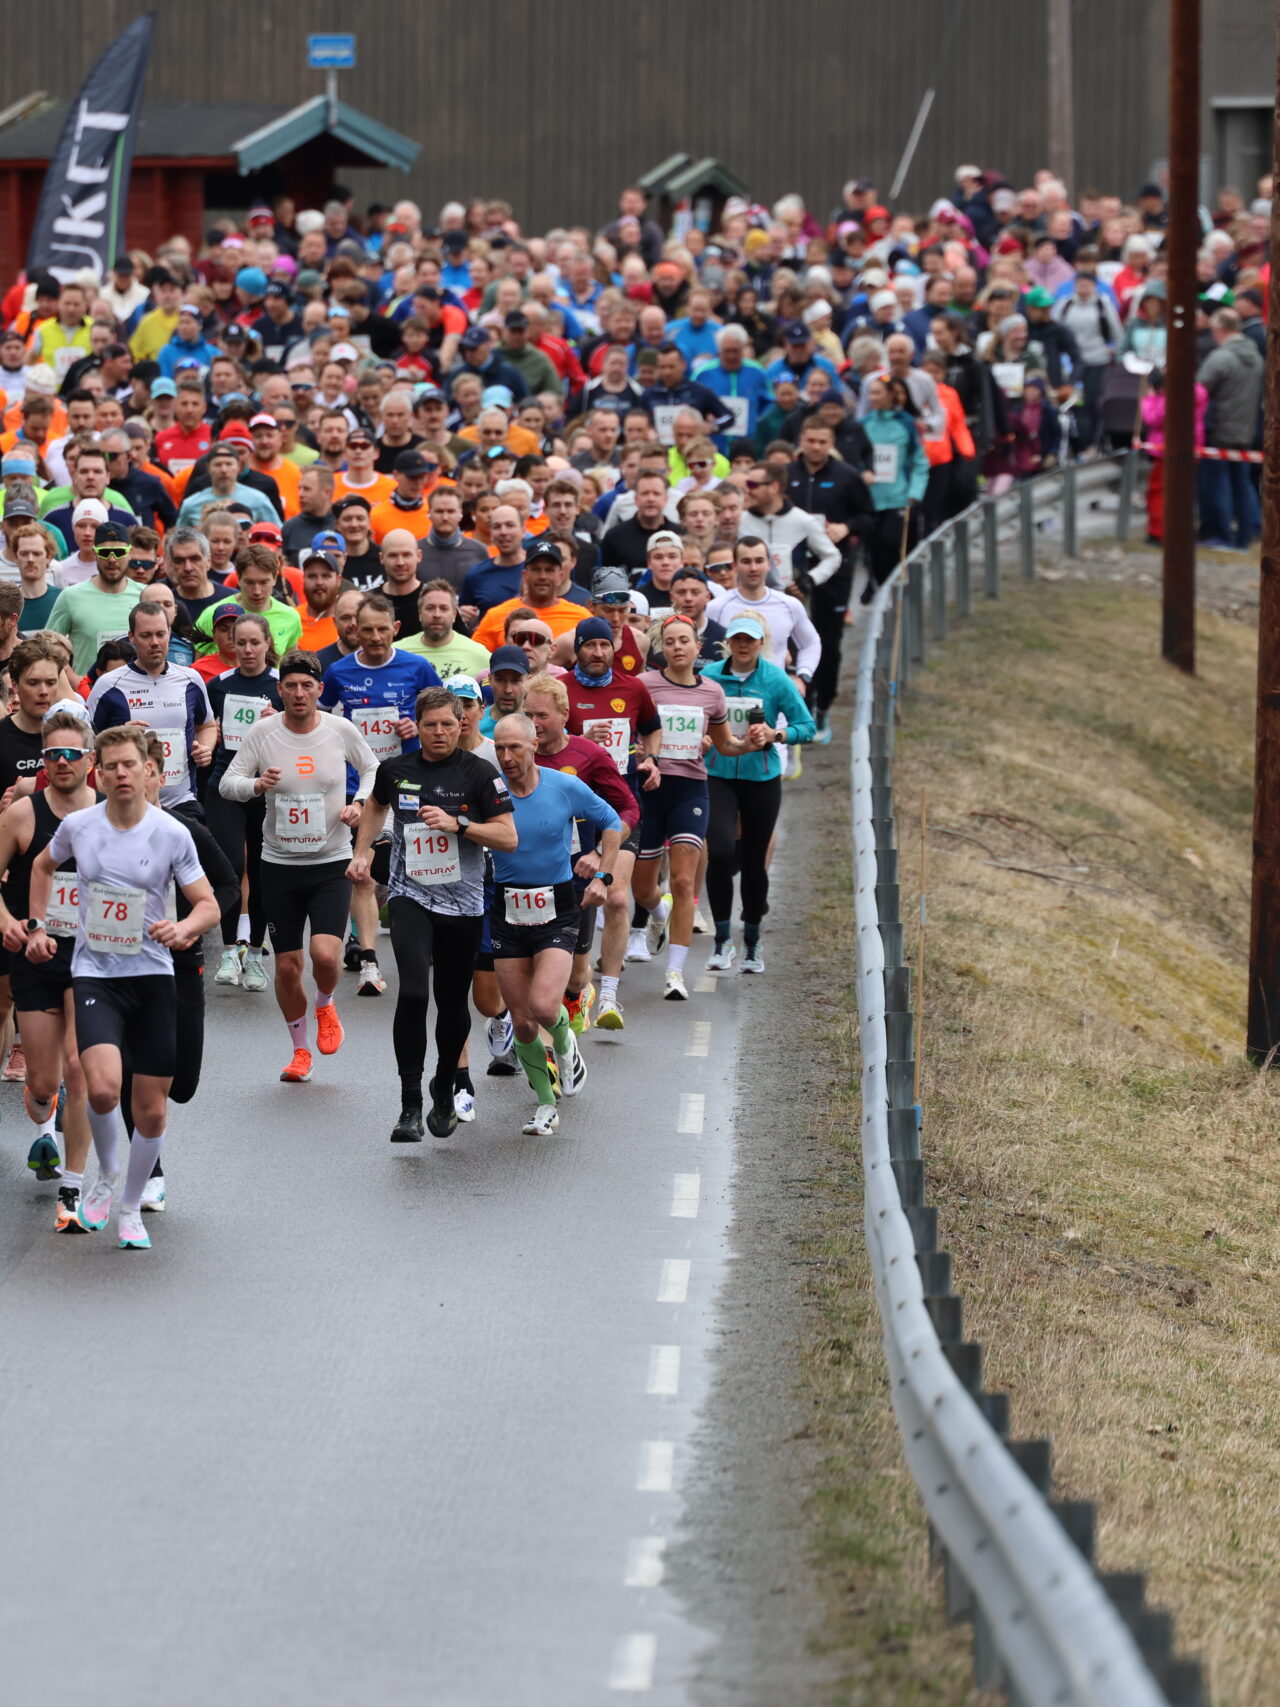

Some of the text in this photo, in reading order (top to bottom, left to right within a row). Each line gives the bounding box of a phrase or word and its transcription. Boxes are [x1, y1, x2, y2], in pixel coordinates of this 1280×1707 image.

[48, 98, 131, 286] UKET
[233, 707, 256, 725] 49
[666, 716, 697, 733] 134
[360, 719, 393, 736] 143
[602, 731, 624, 748] 87
[16, 758, 46, 770] CRA
[288, 807, 309, 825] 51
[280, 836, 318, 844] RETURA
[413, 835, 450, 855] 119
[410, 867, 452, 877] RETURA
[56, 886, 81, 907] 16
[511, 891, 548, 910] 116
[101, 899, 128, 922] 78
[88, 932, 133, 944] RETURA
